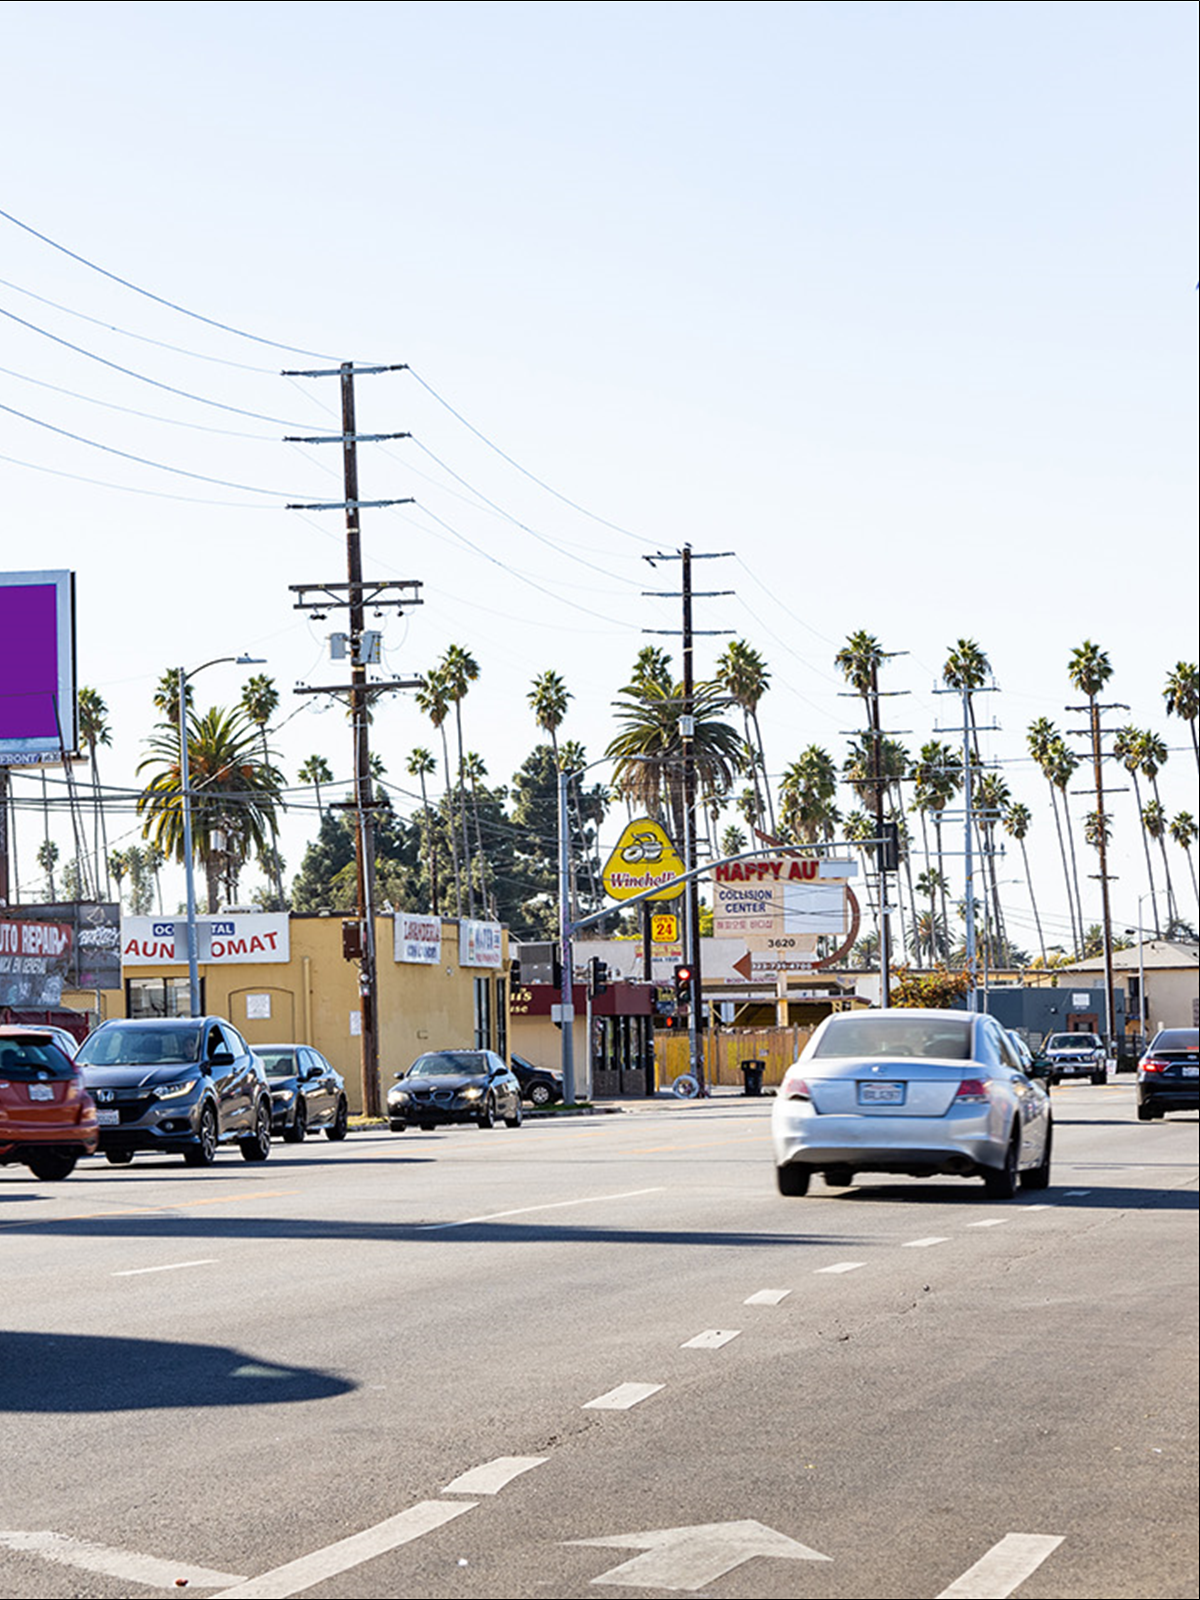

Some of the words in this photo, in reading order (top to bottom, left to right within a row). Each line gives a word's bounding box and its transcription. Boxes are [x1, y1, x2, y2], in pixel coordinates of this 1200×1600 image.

[715, 861, 783, 881] HAPPY
[788, 861, 841, 880] AU
[610, 871, 678, 889] Winchell'
[719, 889, 773, 900] COLLISION
[725, 902, 766, 913] CENTER
[154, 924, 233, 935] OCTAL
[656, 923, 673, 935] 24
[22, 924, 60, 955] REPAIR
[124, 931, 278, 959] AUNOMAT
[767, 939, 795, 948] 3620
